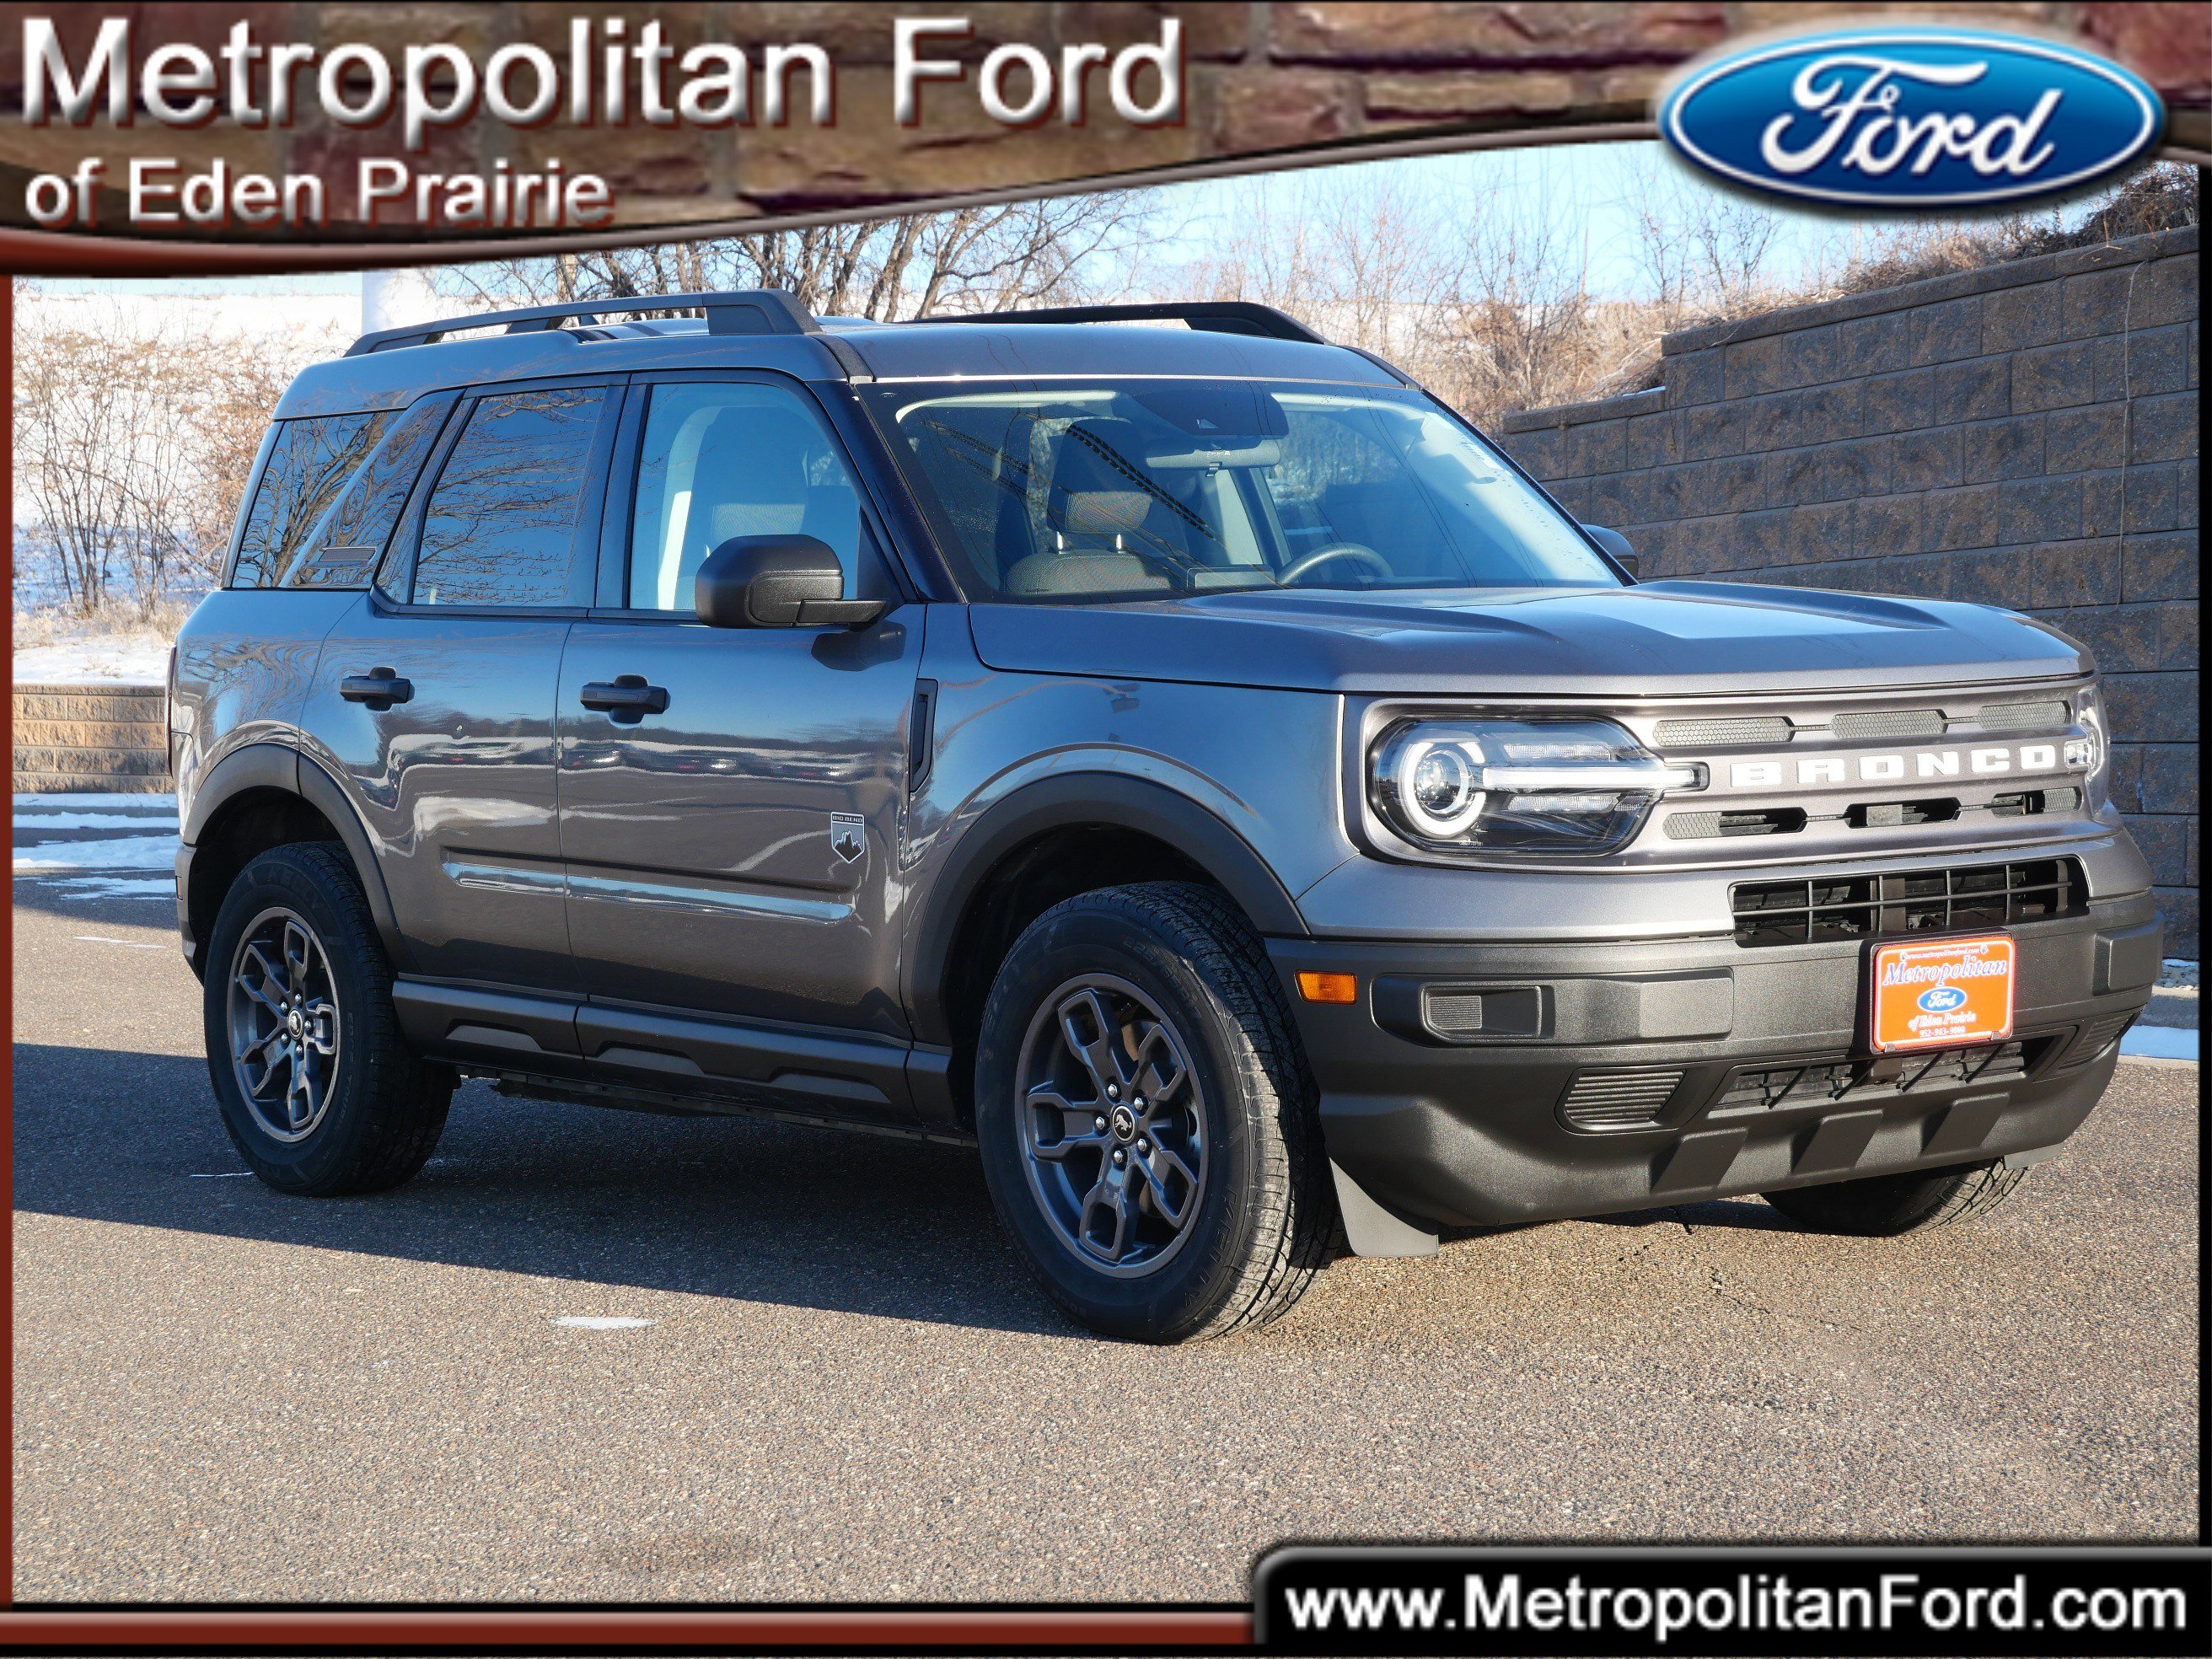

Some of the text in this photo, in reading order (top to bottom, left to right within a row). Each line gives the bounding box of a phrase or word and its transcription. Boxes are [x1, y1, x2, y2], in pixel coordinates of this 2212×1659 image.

[1729, 744, 2056, 788] BRONCO
[1882, 954, 2007, 986] Metropolitan
[1927, 991, 1957, 1008] Ford
[1908, 1011, 1977, 1032] of Eden Prairie
